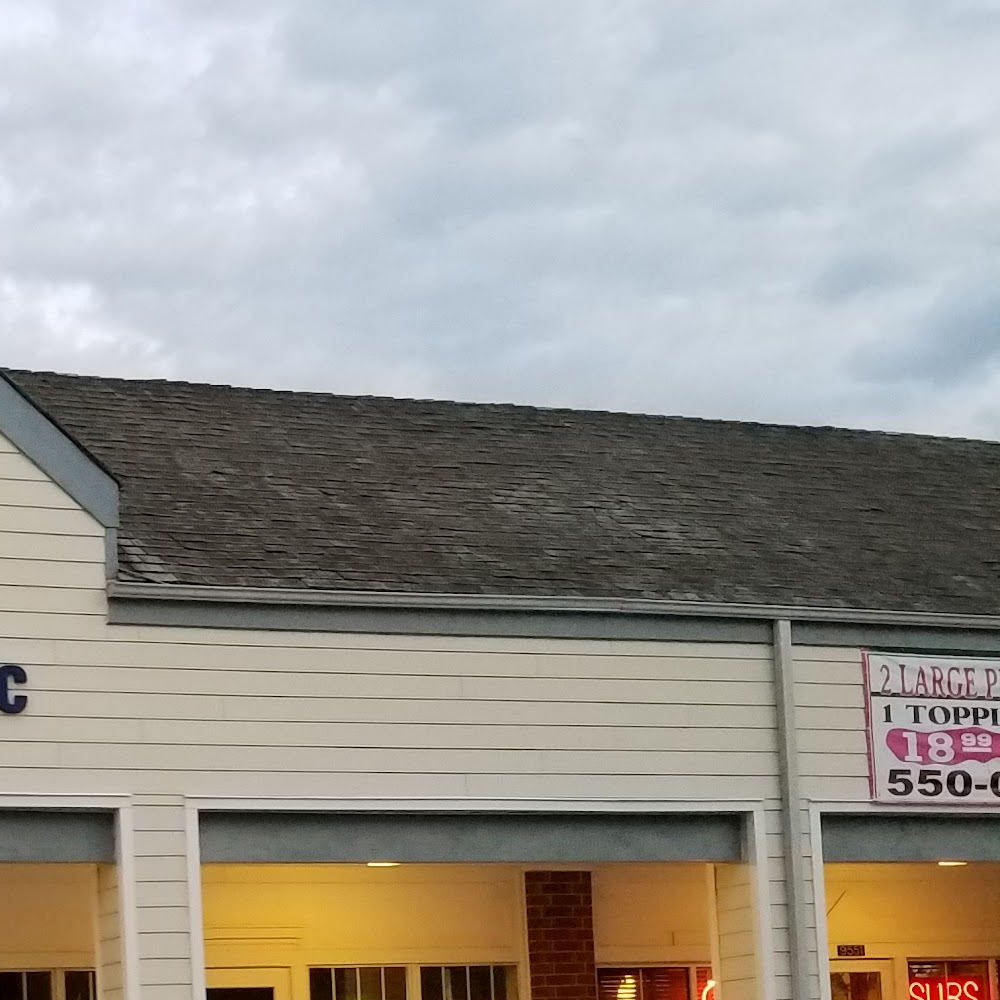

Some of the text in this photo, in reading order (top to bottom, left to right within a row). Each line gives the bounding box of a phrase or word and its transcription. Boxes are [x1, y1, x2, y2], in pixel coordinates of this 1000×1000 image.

[880, 664, 893, 696] 2
[898, 664, 979, 698] LARGE
[882, 704, 894, 723] 1
[839, 944, 866, 956] 9551
